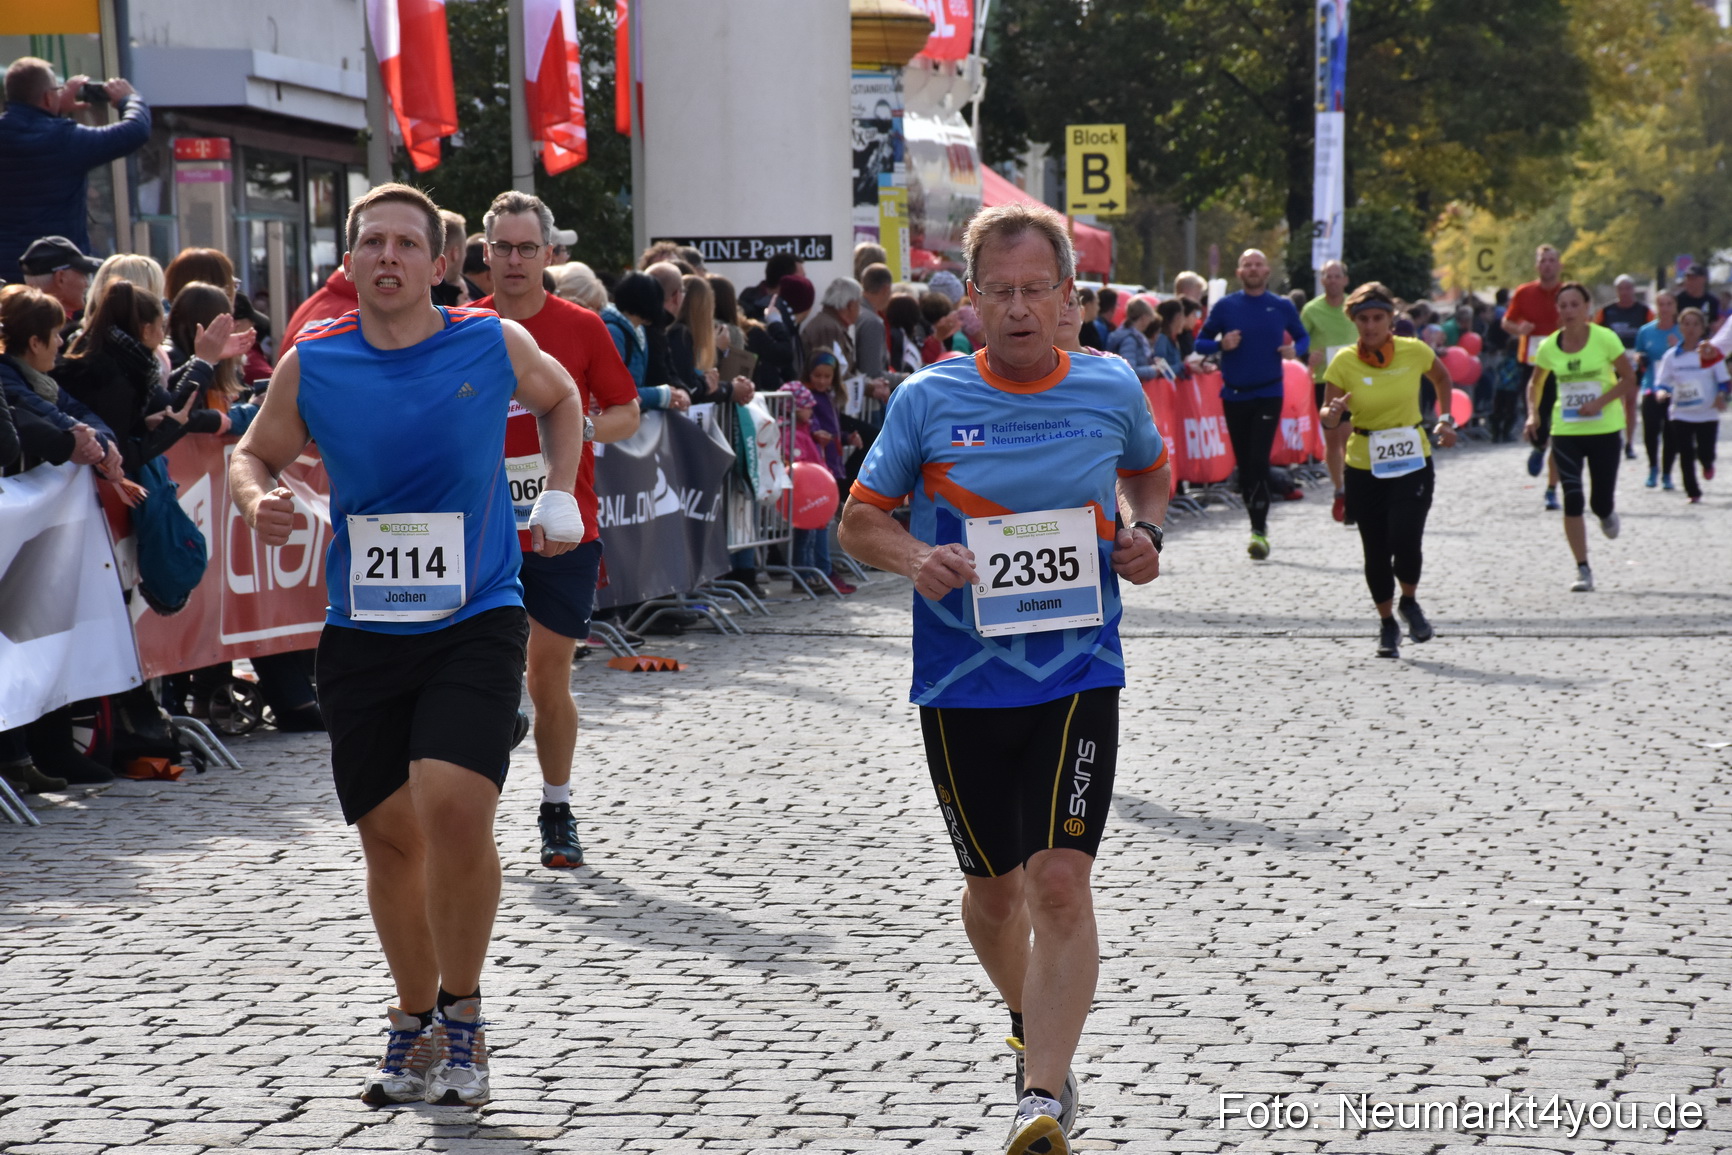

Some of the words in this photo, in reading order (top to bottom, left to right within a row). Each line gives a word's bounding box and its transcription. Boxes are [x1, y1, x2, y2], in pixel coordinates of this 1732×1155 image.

[1073, 128, 1118, 145] Block
[1082, 152, 1111, 195] B
[1477, 248, 1494, 273] C
[991, 418, 1071, 433] Raiffeisenbank
[992, 432, 1047, 445] Neumarkt
[1090, 429, 1103, 438] eG
[1377, 440, 1415, 460] 2432
[391, 523, 429, 532] BOCK
[1016, 521, 1059, 535] BOCK
[366, 546, 447, 579] 2114
[989, 546, 1080, 589] 2335
[385, 591, 427, 603] Jochen
[1016, 598, 1062, 613] Johann
[1069, 738, 1096, 818] SKINS
[943, 804, 976, 869] SKINS
